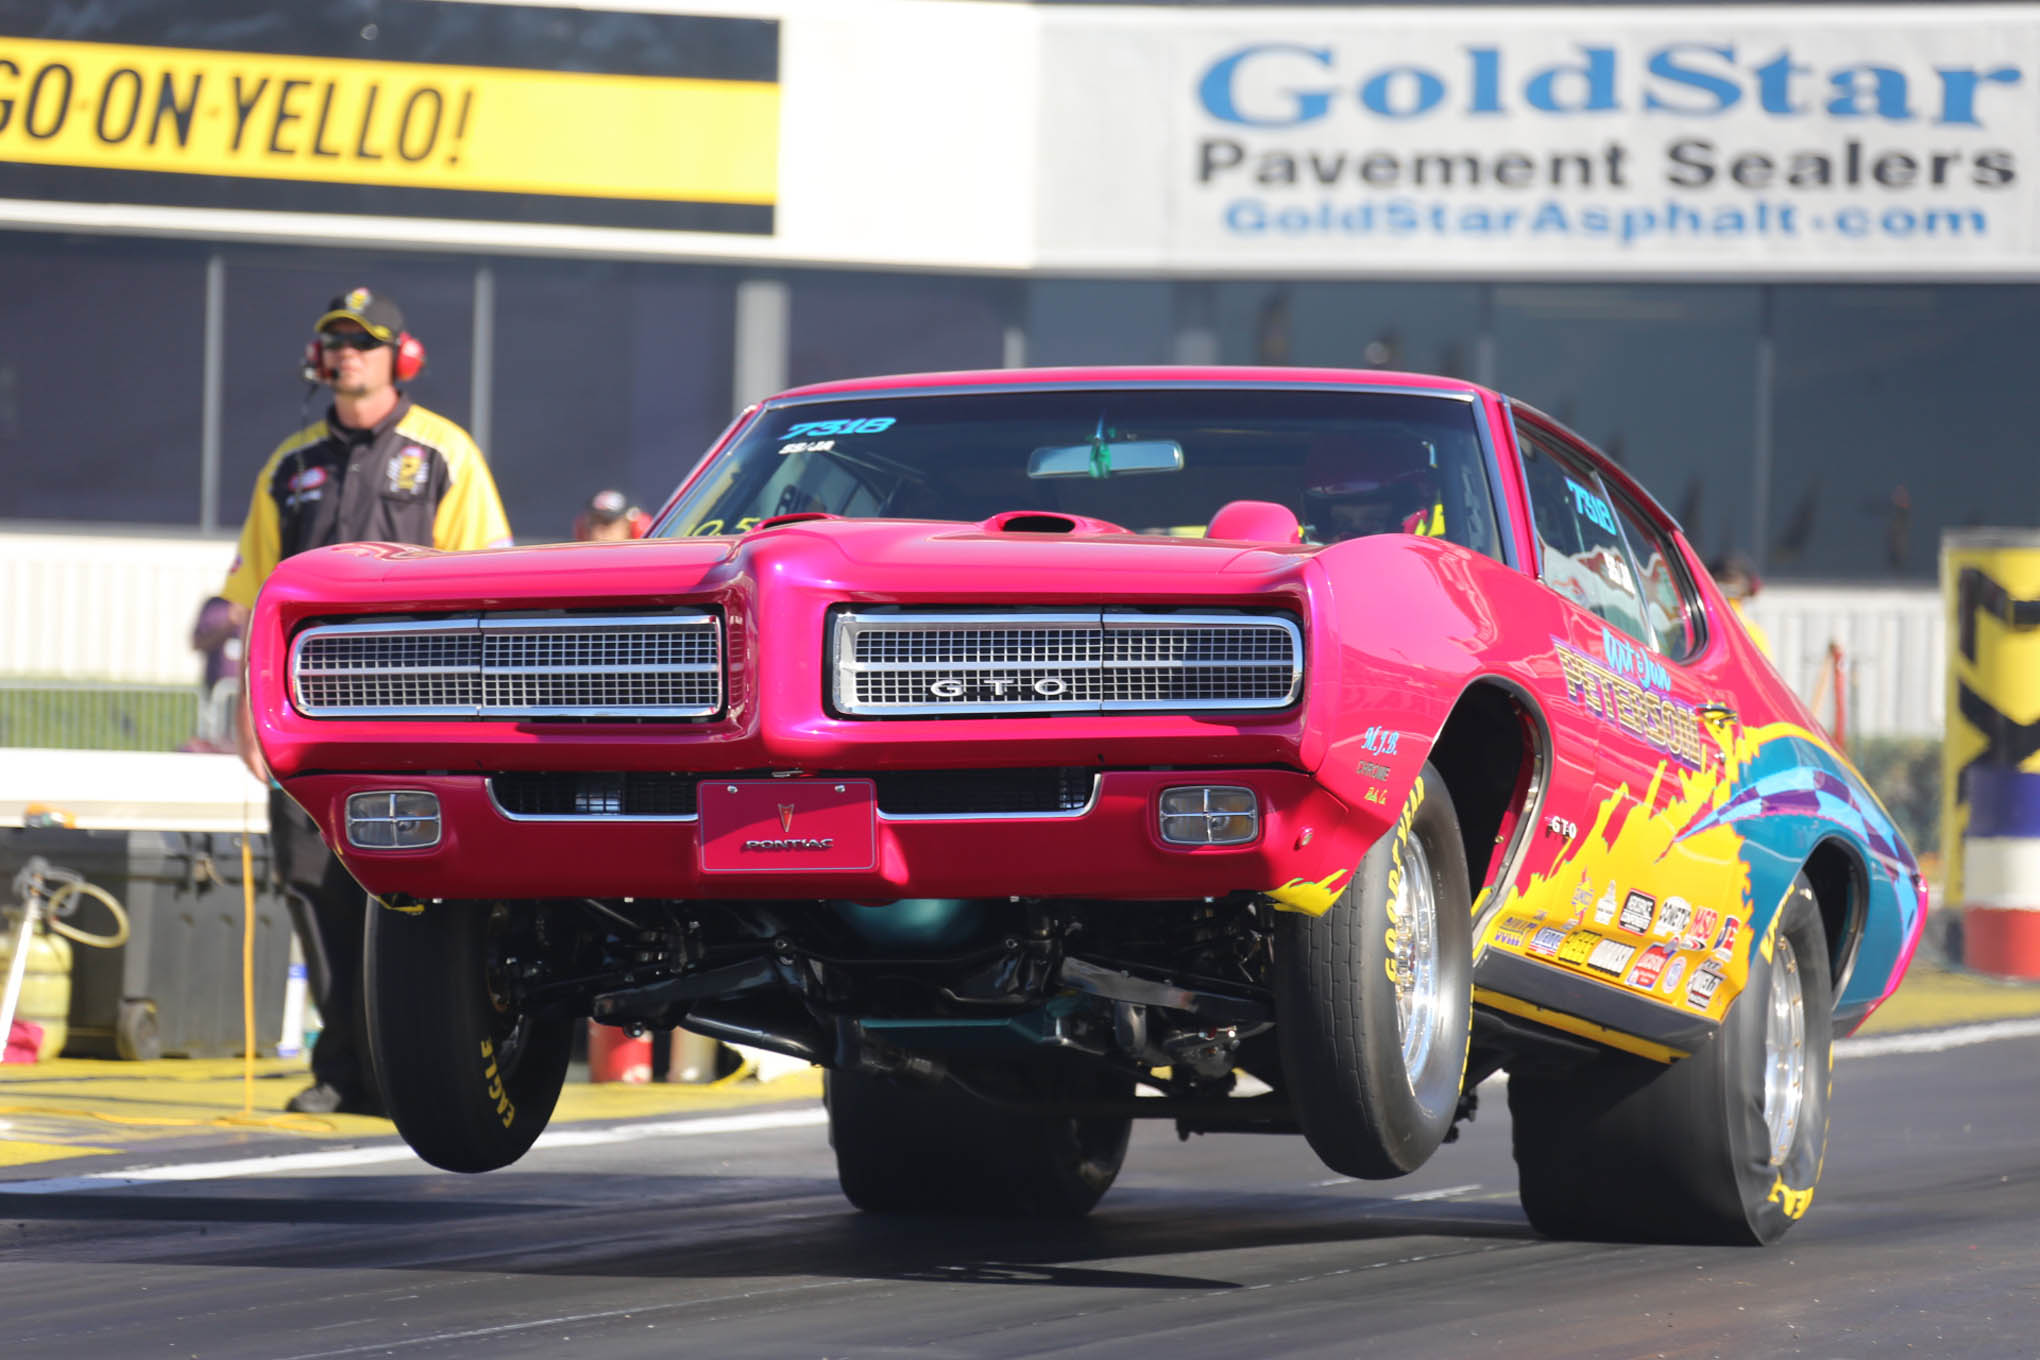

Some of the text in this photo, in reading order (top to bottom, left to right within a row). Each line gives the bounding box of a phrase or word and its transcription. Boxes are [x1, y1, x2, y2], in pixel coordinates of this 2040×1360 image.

[1197, 42, 2024, 130] GoldStar
[1198, 136, 2018, 190] Pavement Sealers
[777, 416, 897, 440] 7318
[930, 679, 1067, 697] GTO
[1550, 636, 1702, 772] PETERSON
[1551, 815, 1577, 839] GTO
[745, 838, 834, 849] PONTIAC
